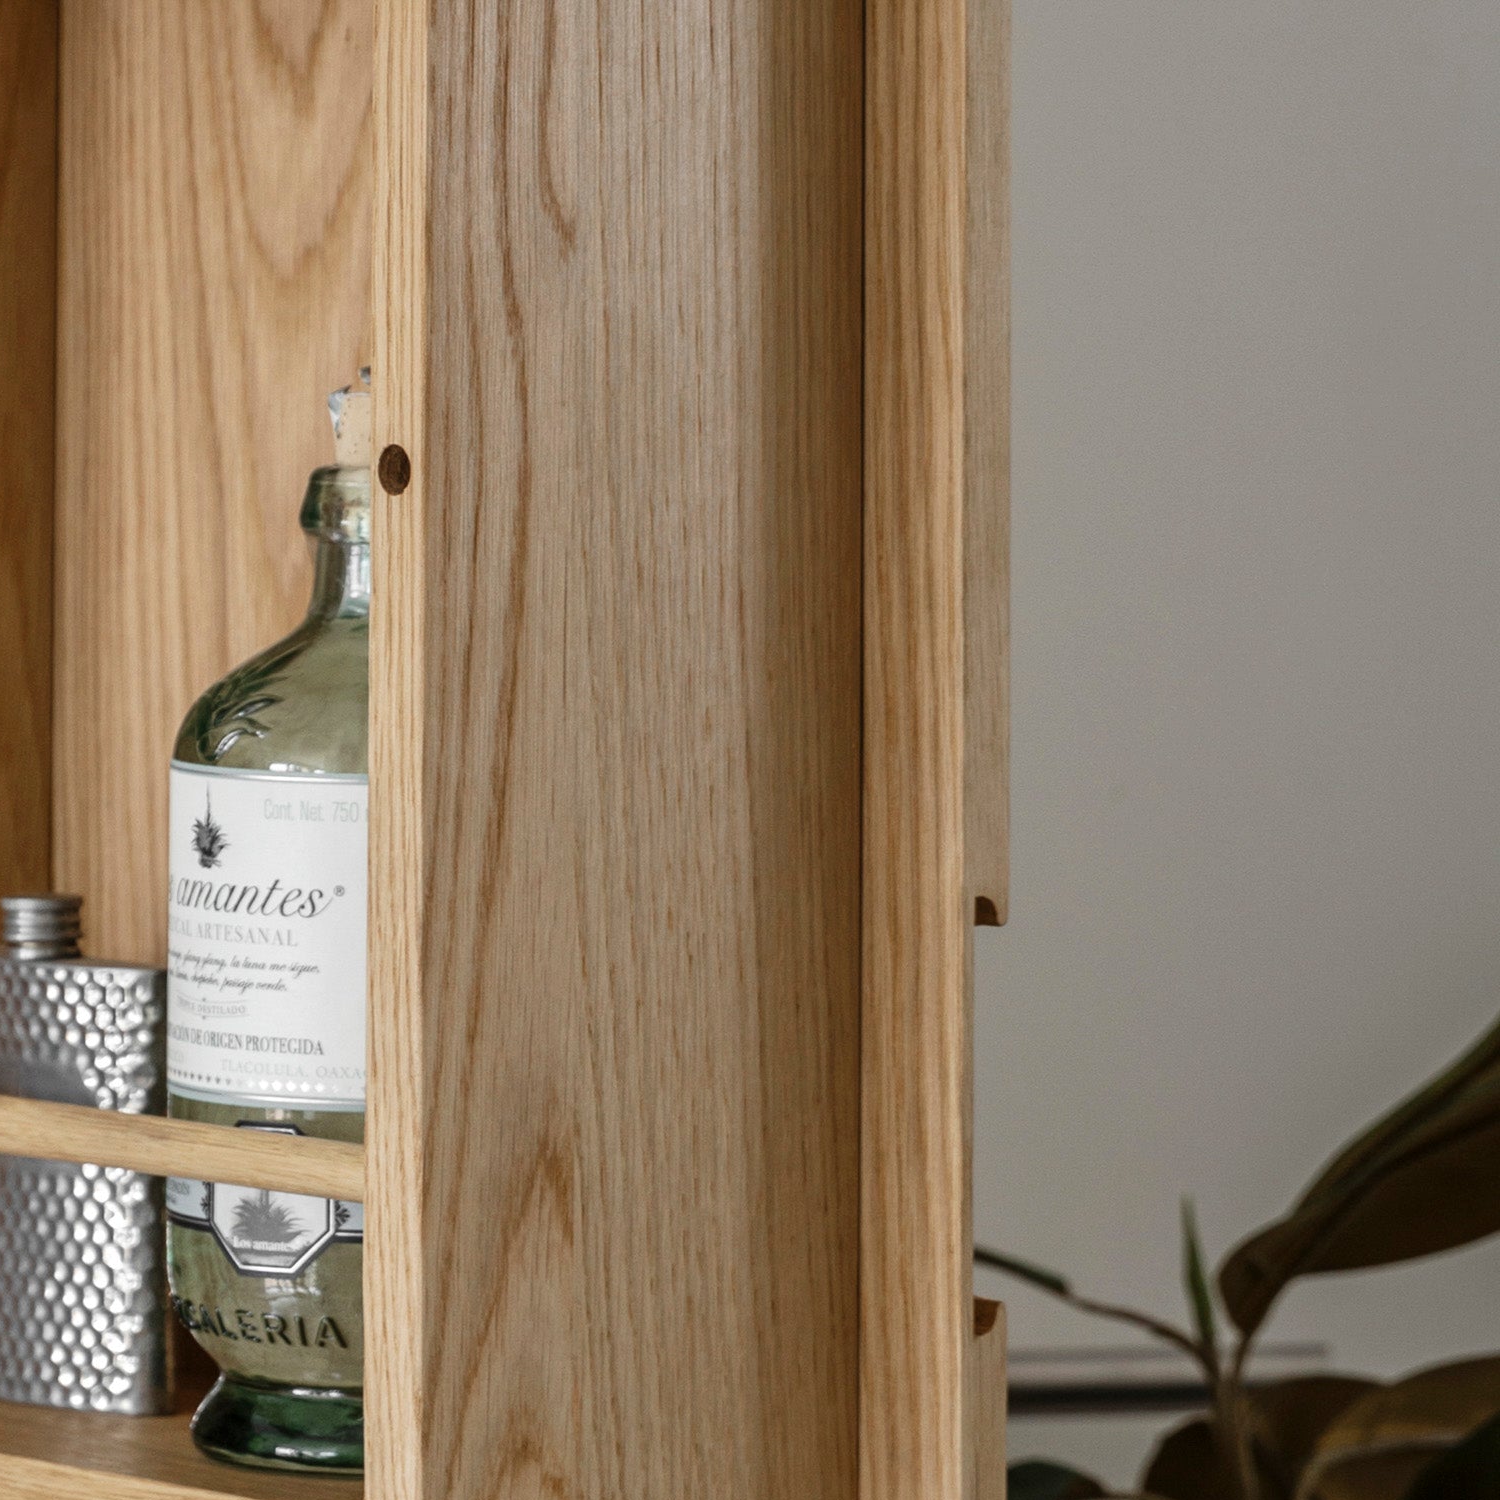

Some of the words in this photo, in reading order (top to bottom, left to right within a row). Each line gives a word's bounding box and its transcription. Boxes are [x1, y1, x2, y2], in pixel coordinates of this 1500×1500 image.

[332, 802, 359, 823] 750
[197, 922, 298, 947] ARTESANAL
[269, 963, 286, 972] me
[197, 1003, 246, 1015] DESTILADO
[190, 1027, 203, 1045] DE
[203, 1029, 243, 1050] ORIGEN
[245, 1034, 325, 1056] PROTEGIDA
[315, 1065, 366, 1080] OAXA
[232, 1235, 251, 1249] Los
